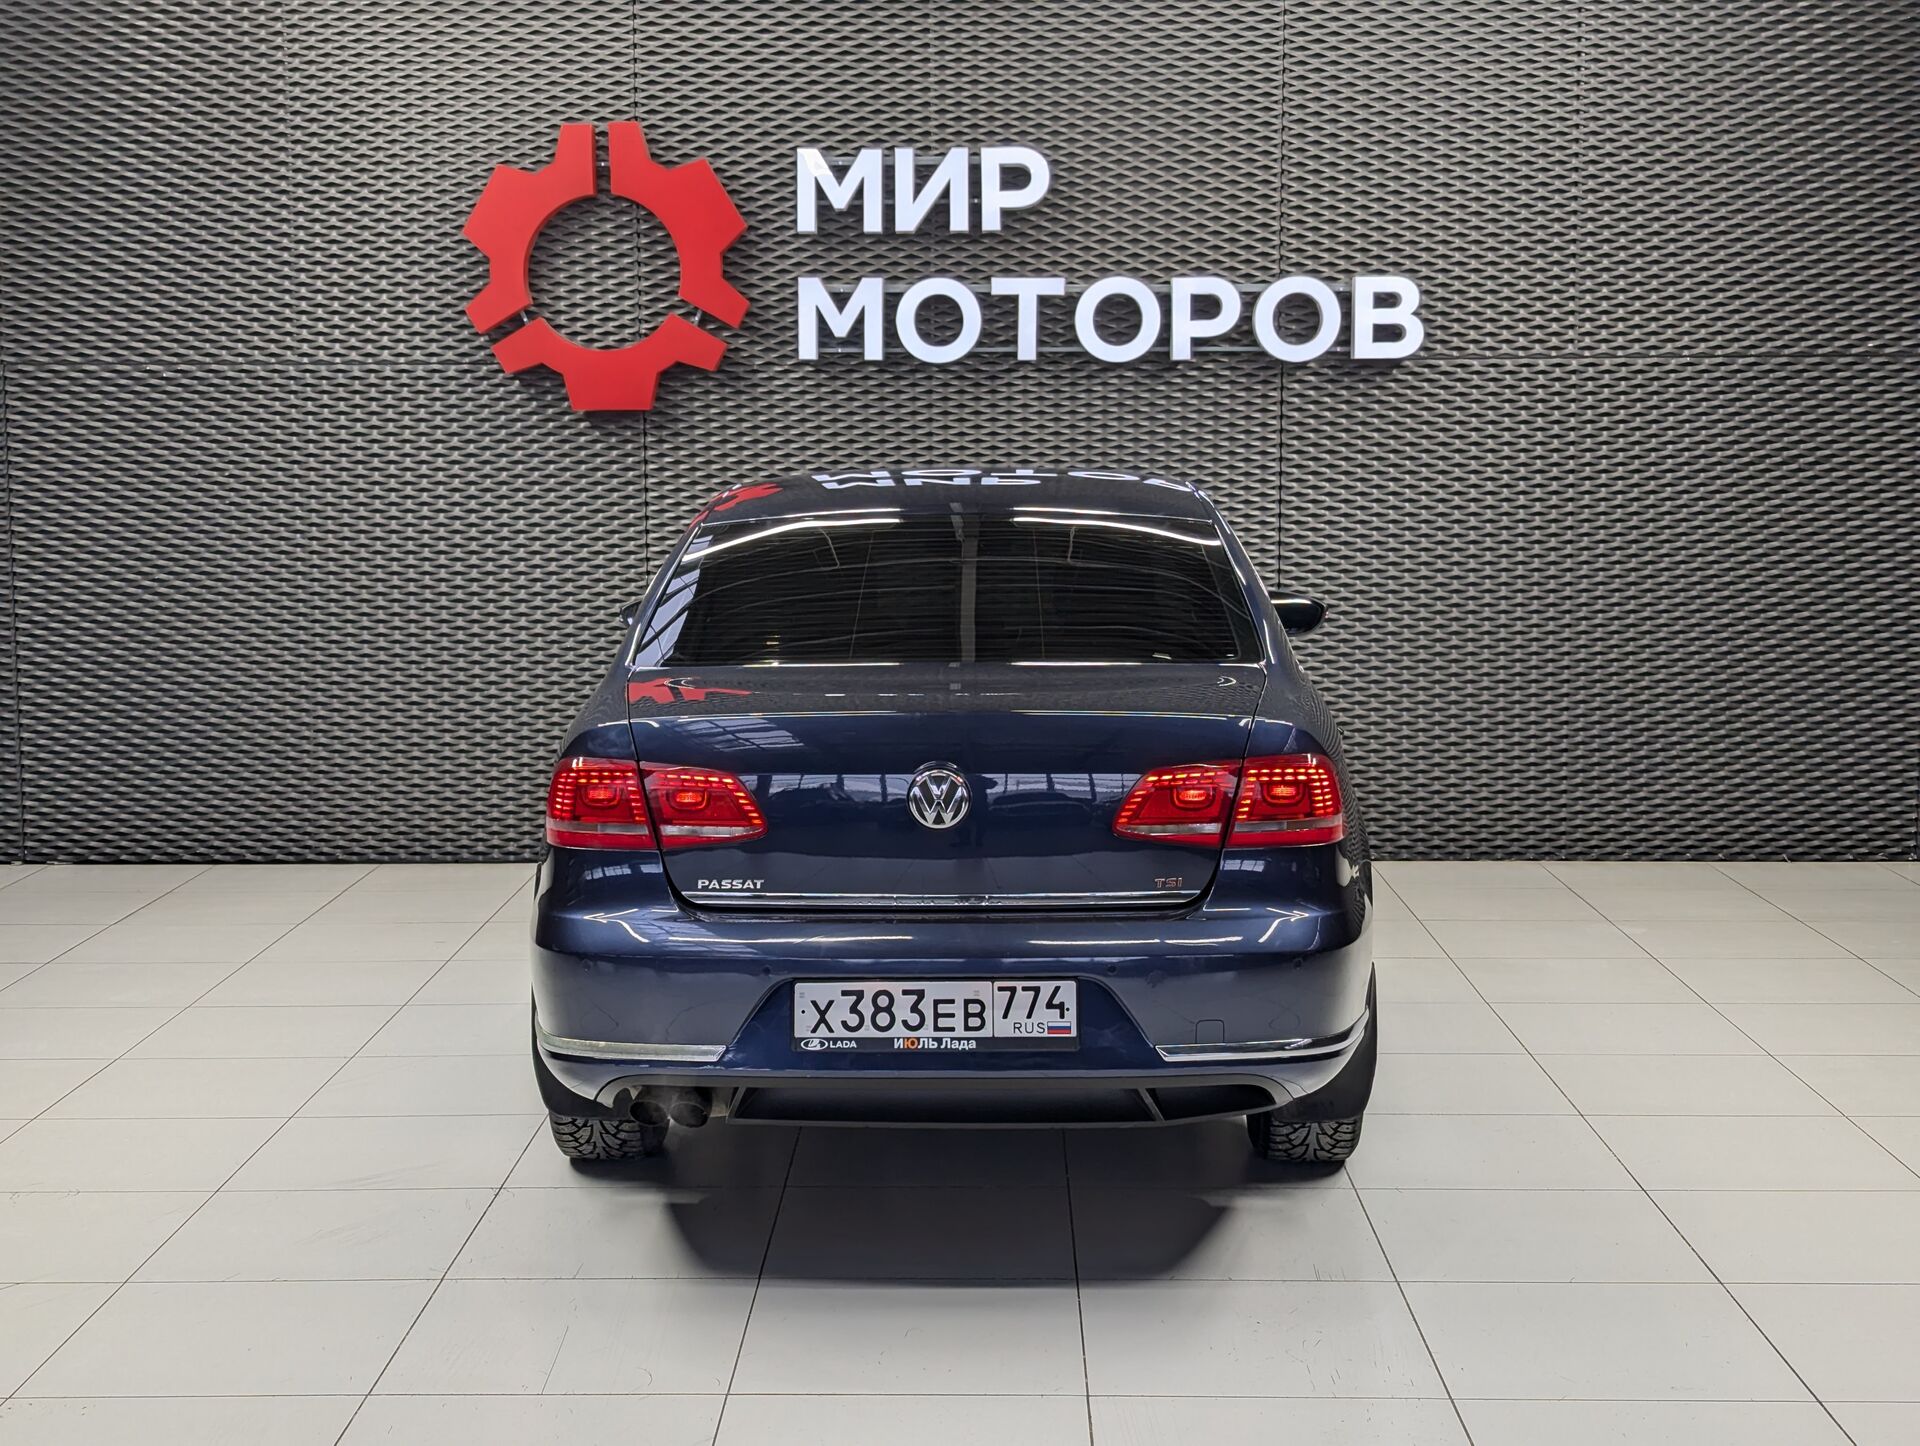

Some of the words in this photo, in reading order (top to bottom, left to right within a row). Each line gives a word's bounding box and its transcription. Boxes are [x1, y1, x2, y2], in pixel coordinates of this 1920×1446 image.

[797, 147, 1050, 233] МИР
[797, 276, 1424, 363] МОТОРОВ
[697, 879, 765, 889] PASSAT
[1154, 877, 1183, 888] TSI
[997, 985, 1065, 1019] 774
[1013, 1021, 1046, 1034] RUS
[894, 1038, 938, 1048] ИЮЛЬ
[941, 1038, 976, 1050] Лада
